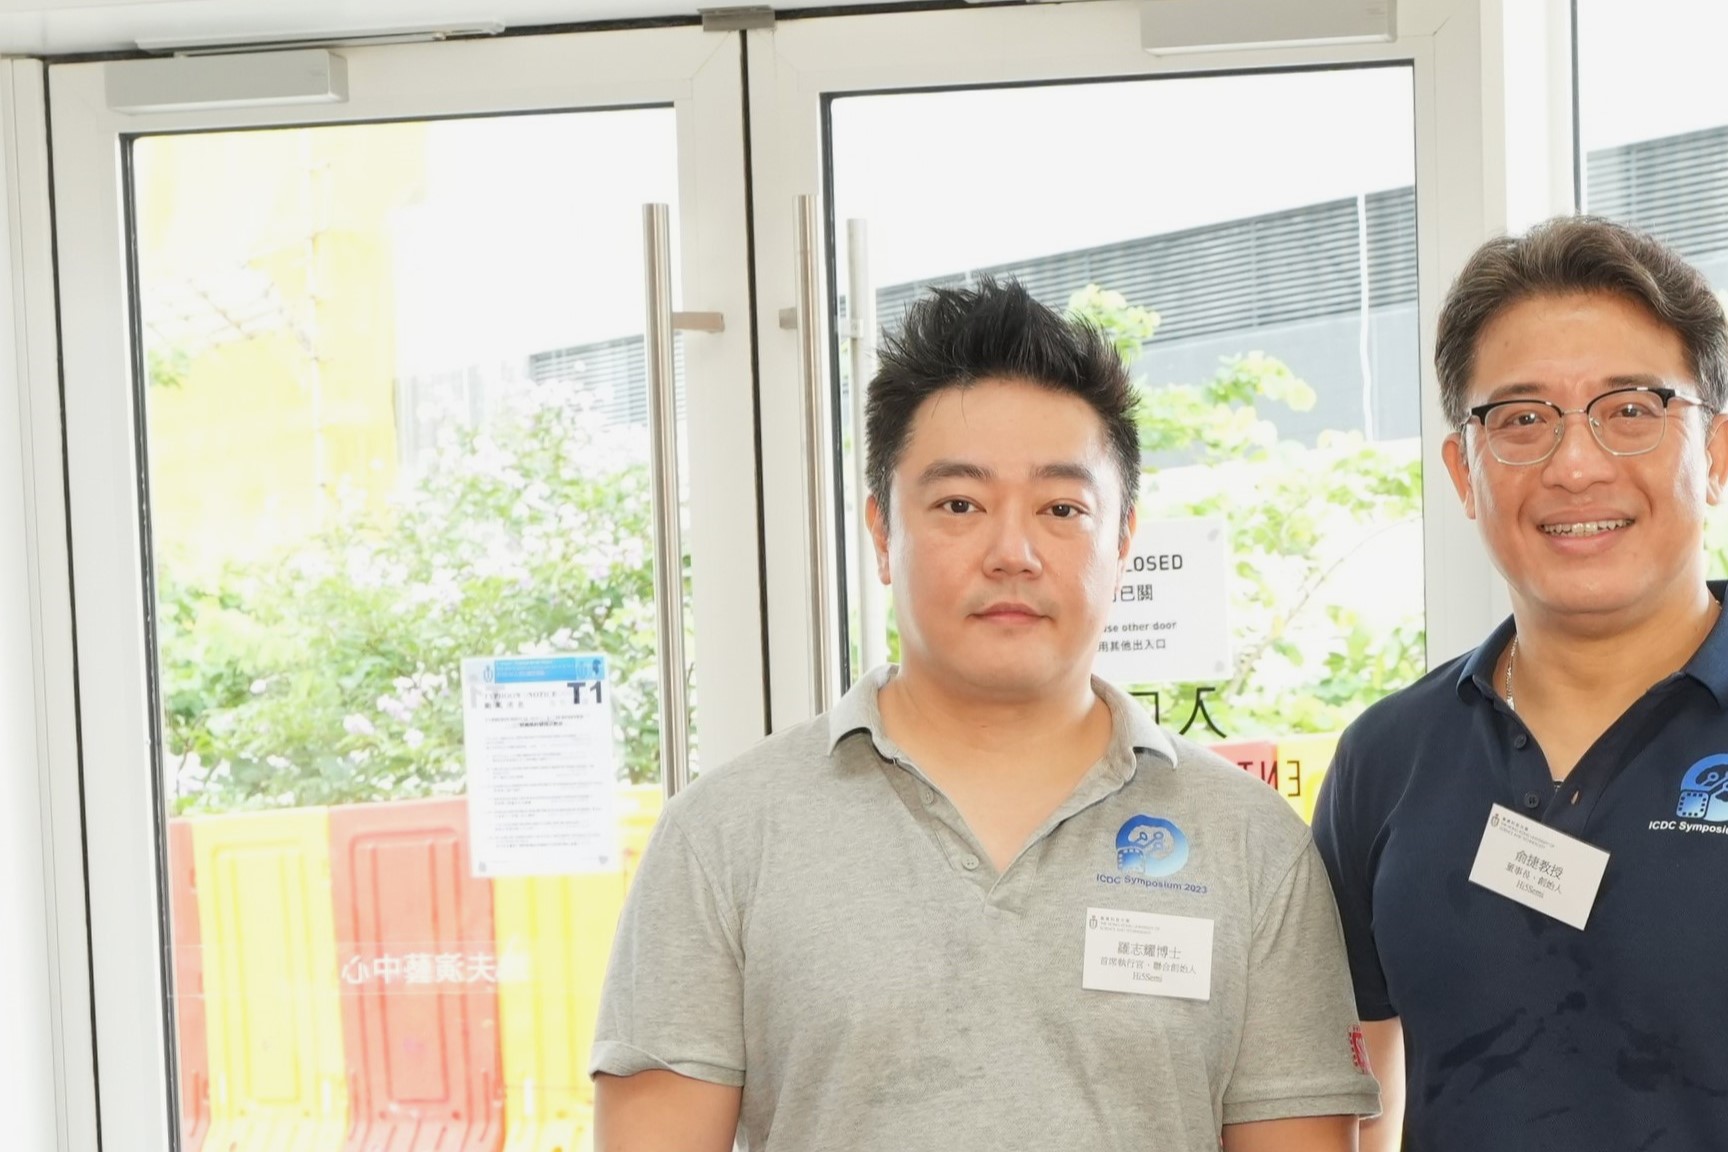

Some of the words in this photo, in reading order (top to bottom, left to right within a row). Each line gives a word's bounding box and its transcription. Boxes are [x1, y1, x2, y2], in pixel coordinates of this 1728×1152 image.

[1126, 554, 1183, 573] OSED
[1122, 622, 1150, 633] other
[1153, 621, 1177, 632] door
[567, 681, 603, 704] T1
[1648, 819, 1677, 832] ICDC
[1514, 849, 1565, 880] 俞捷教授
[1095, 873, 1121, 885] ICDC
[1124, 875, 1182, 891] Symposium
[1184, 883, 1208, 894] 2023
